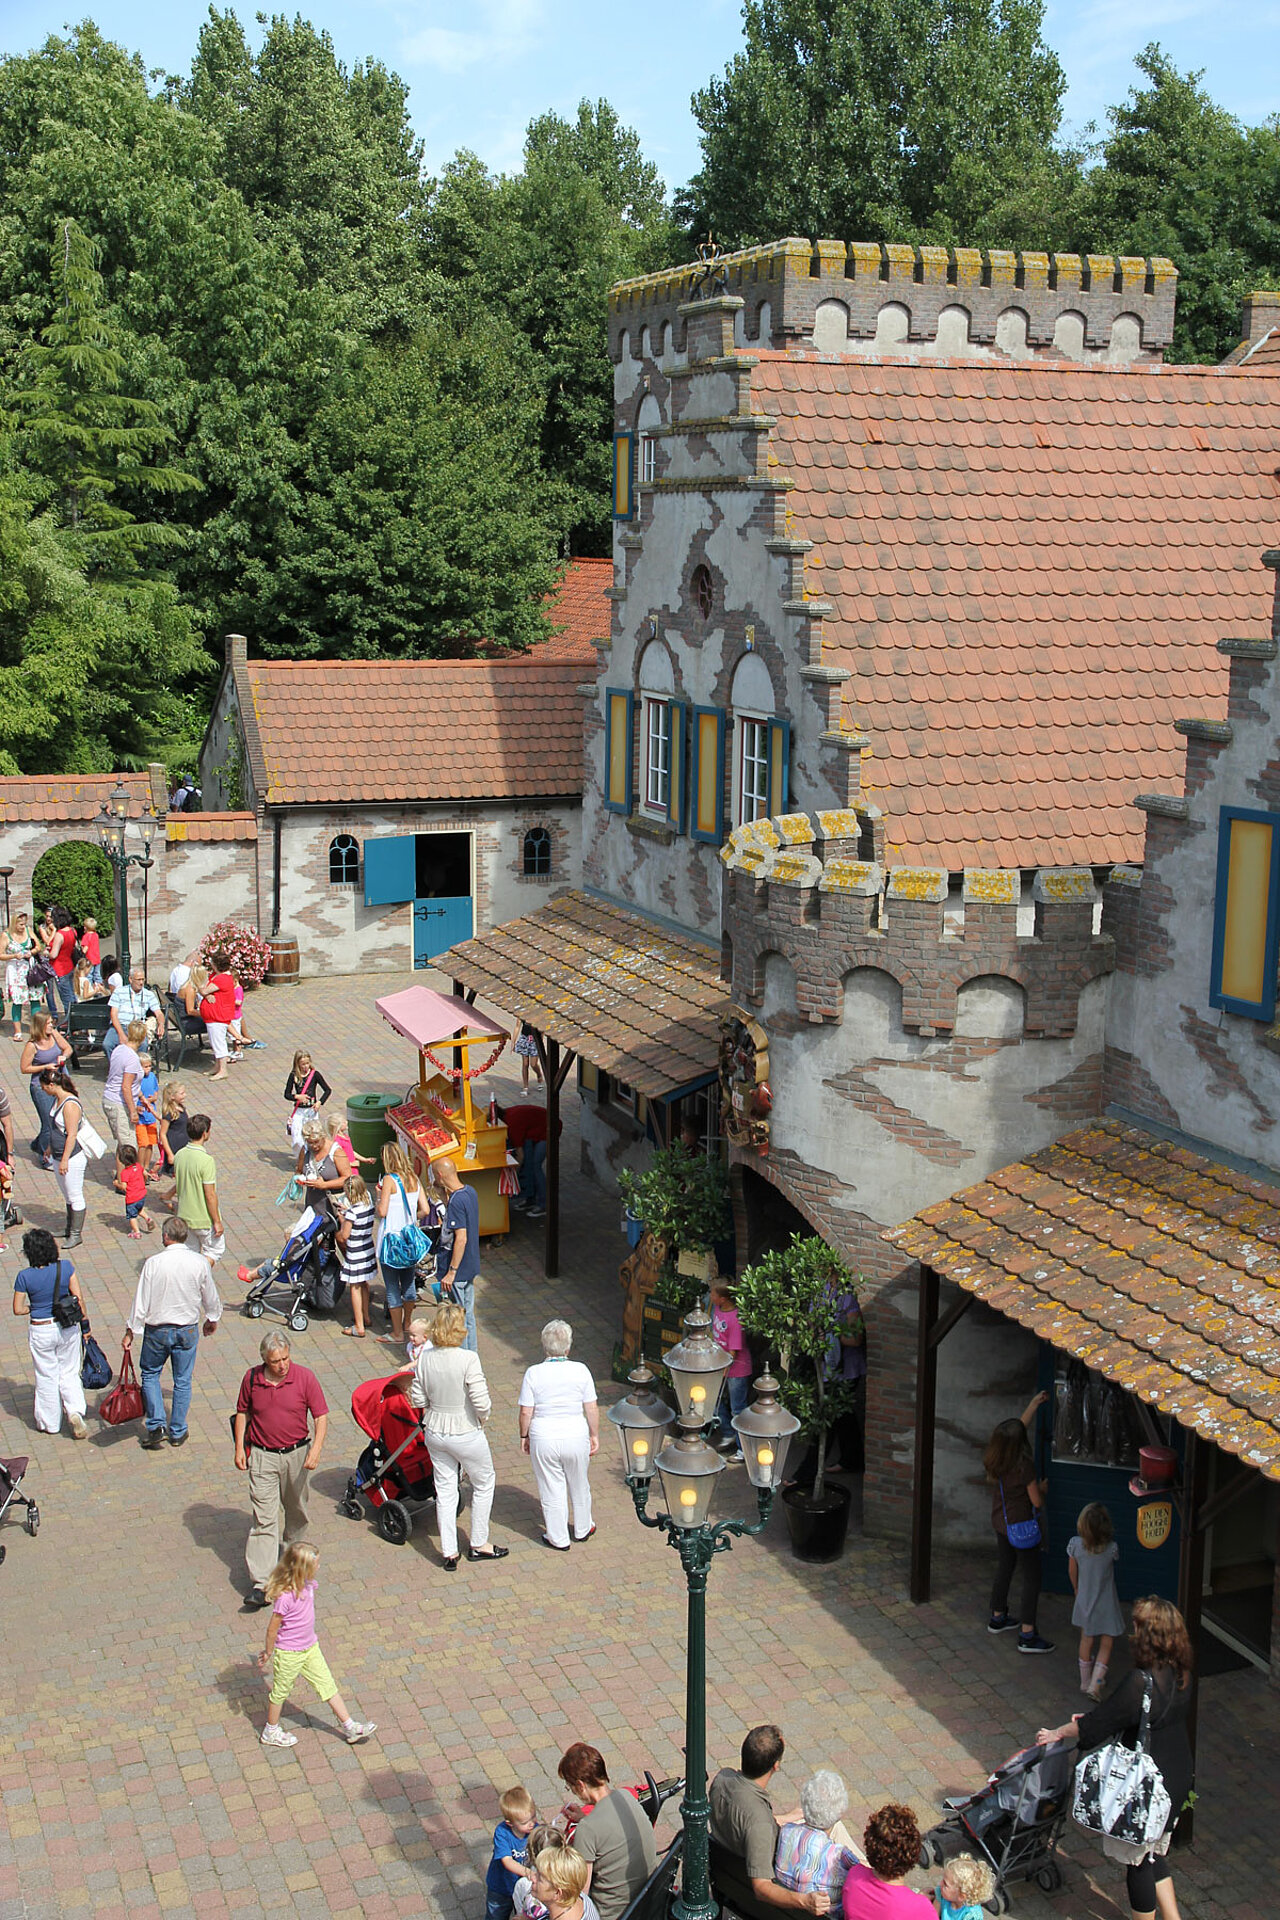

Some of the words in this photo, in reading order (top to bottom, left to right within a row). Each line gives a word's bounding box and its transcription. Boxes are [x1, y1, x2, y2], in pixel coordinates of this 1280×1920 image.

[1144, 1511, 1151, 1520] IN
[1155, 1508, 1169, 1518] DEN
[1145, 1528, 1164, 1539] HOED
